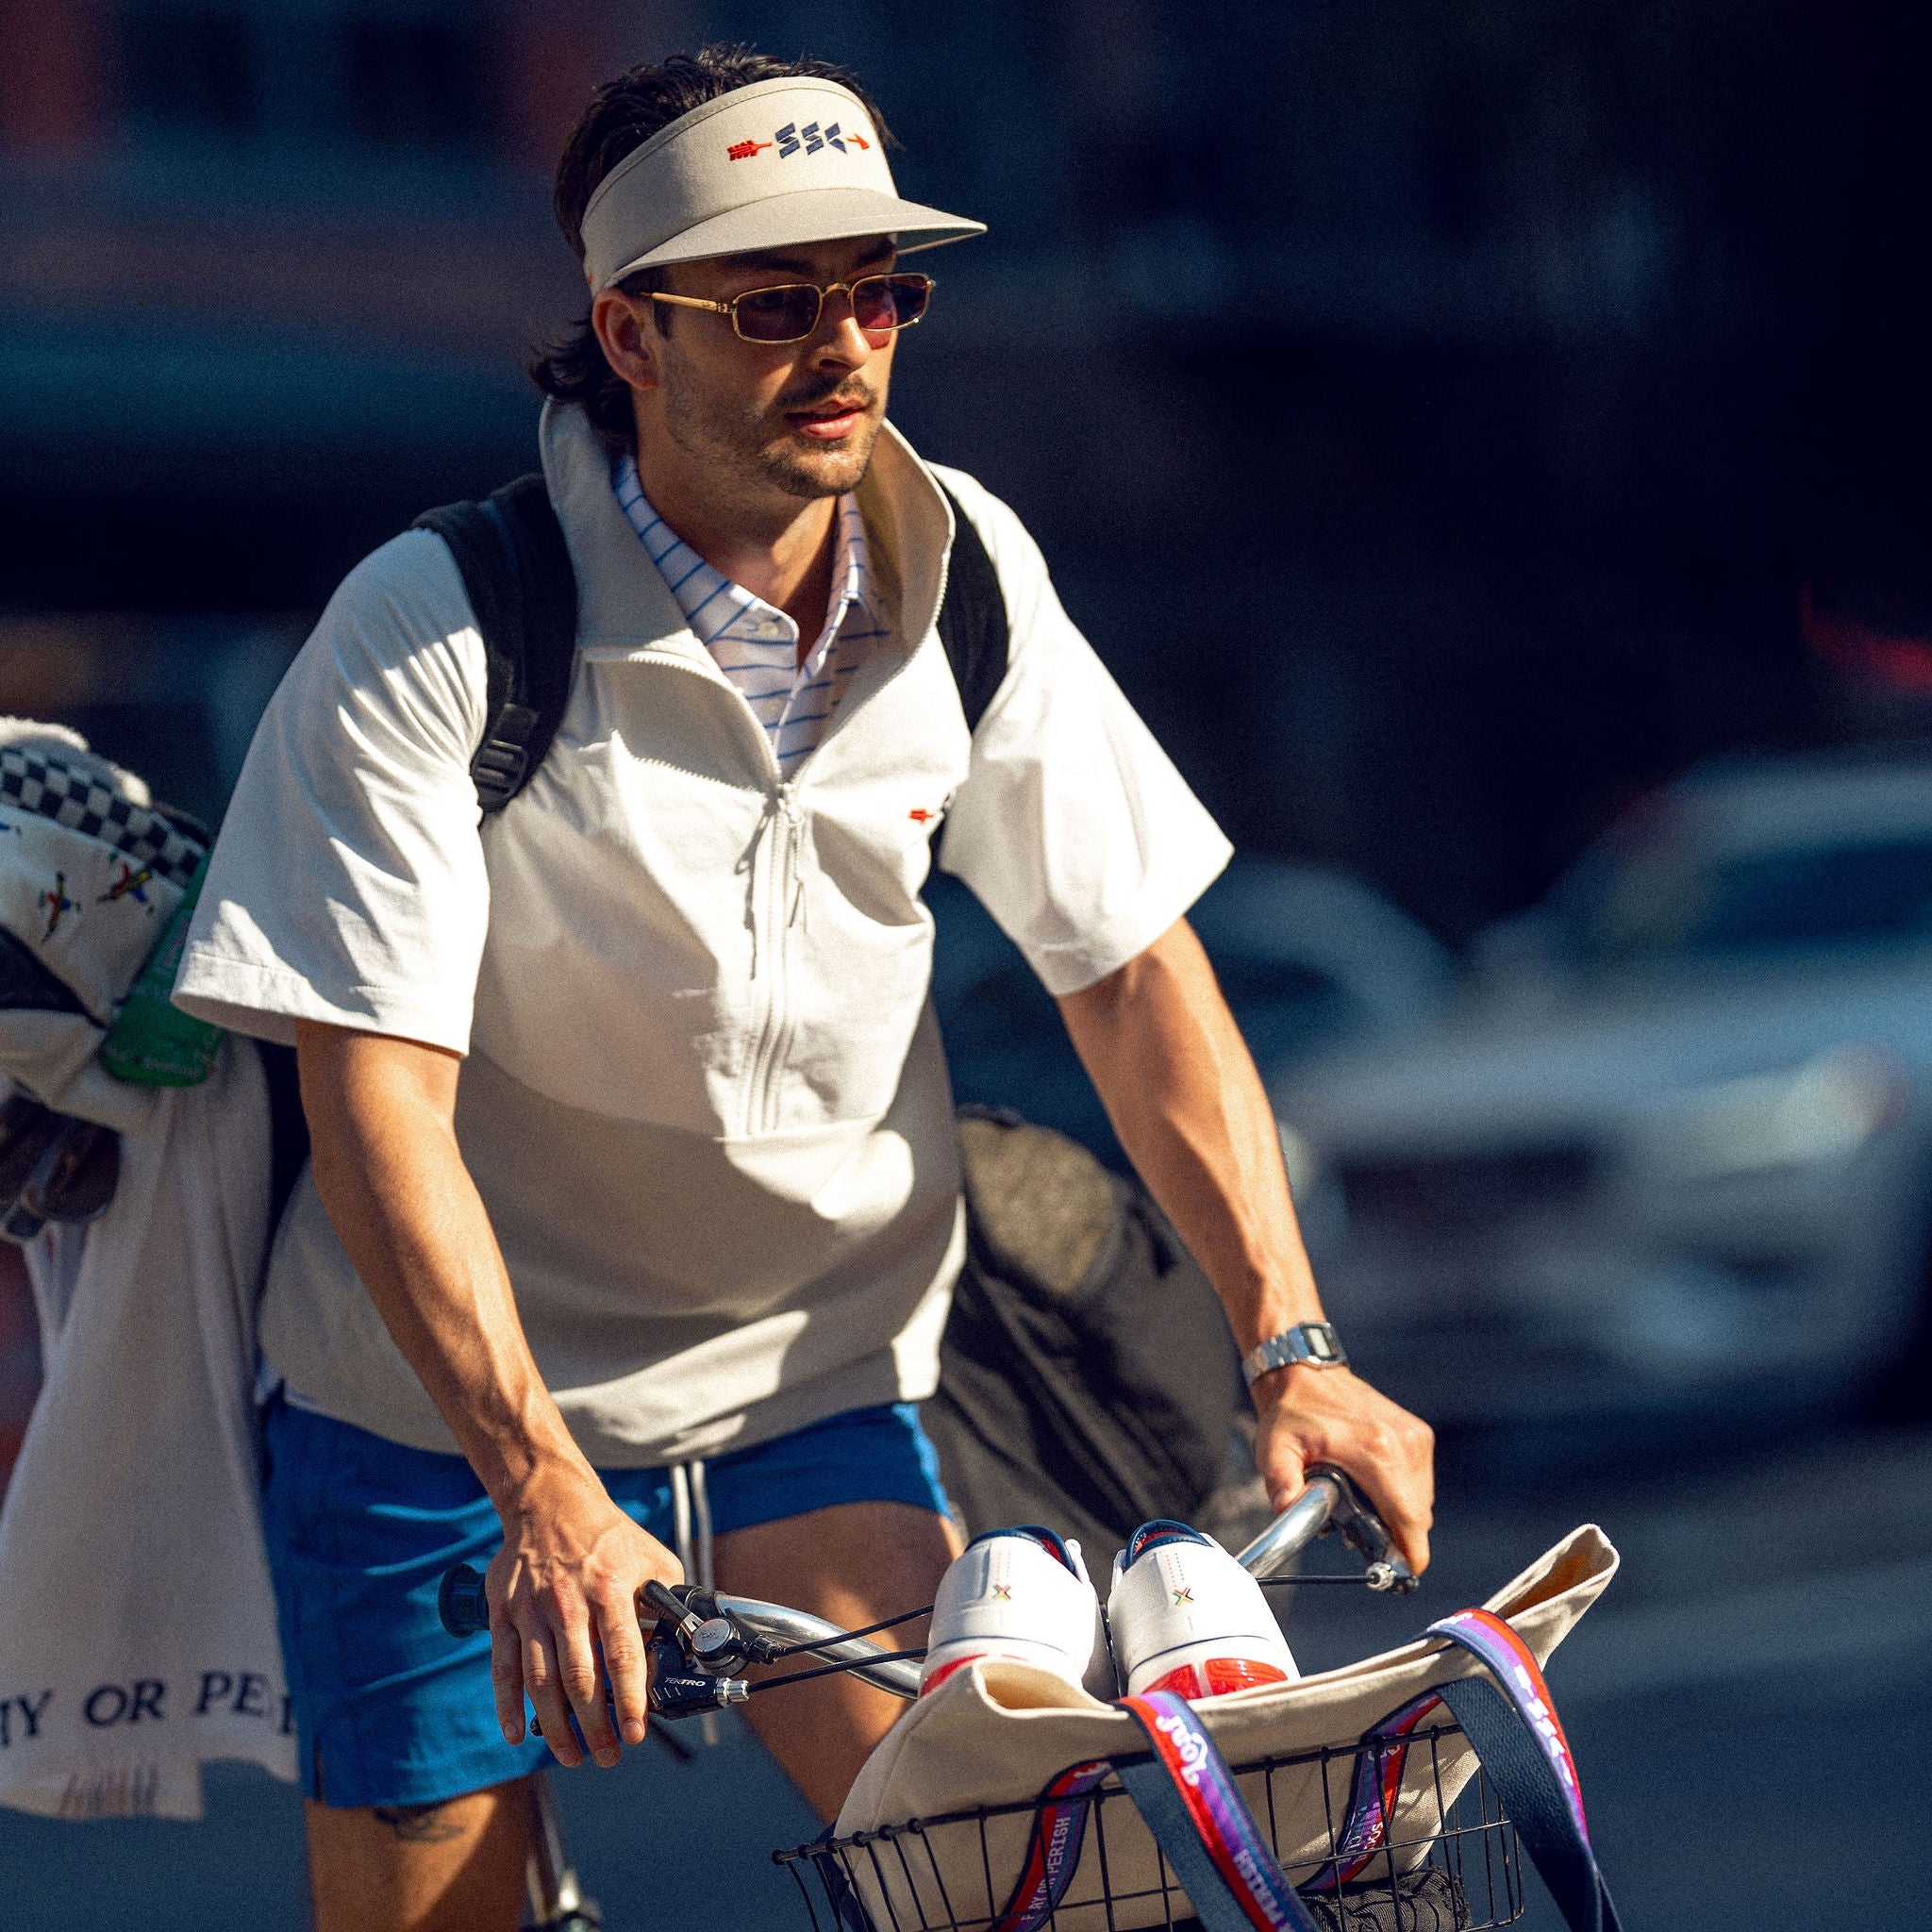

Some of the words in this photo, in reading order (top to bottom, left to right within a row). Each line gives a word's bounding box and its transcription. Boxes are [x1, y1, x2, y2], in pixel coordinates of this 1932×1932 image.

[82, 1678, 167, 1728] OR
[664, 1676, 707, 1687] TEKTRO
[1020, 1894, 1046, 1922] PAY
[1047, 1816, 1072, 1874] PERISH
